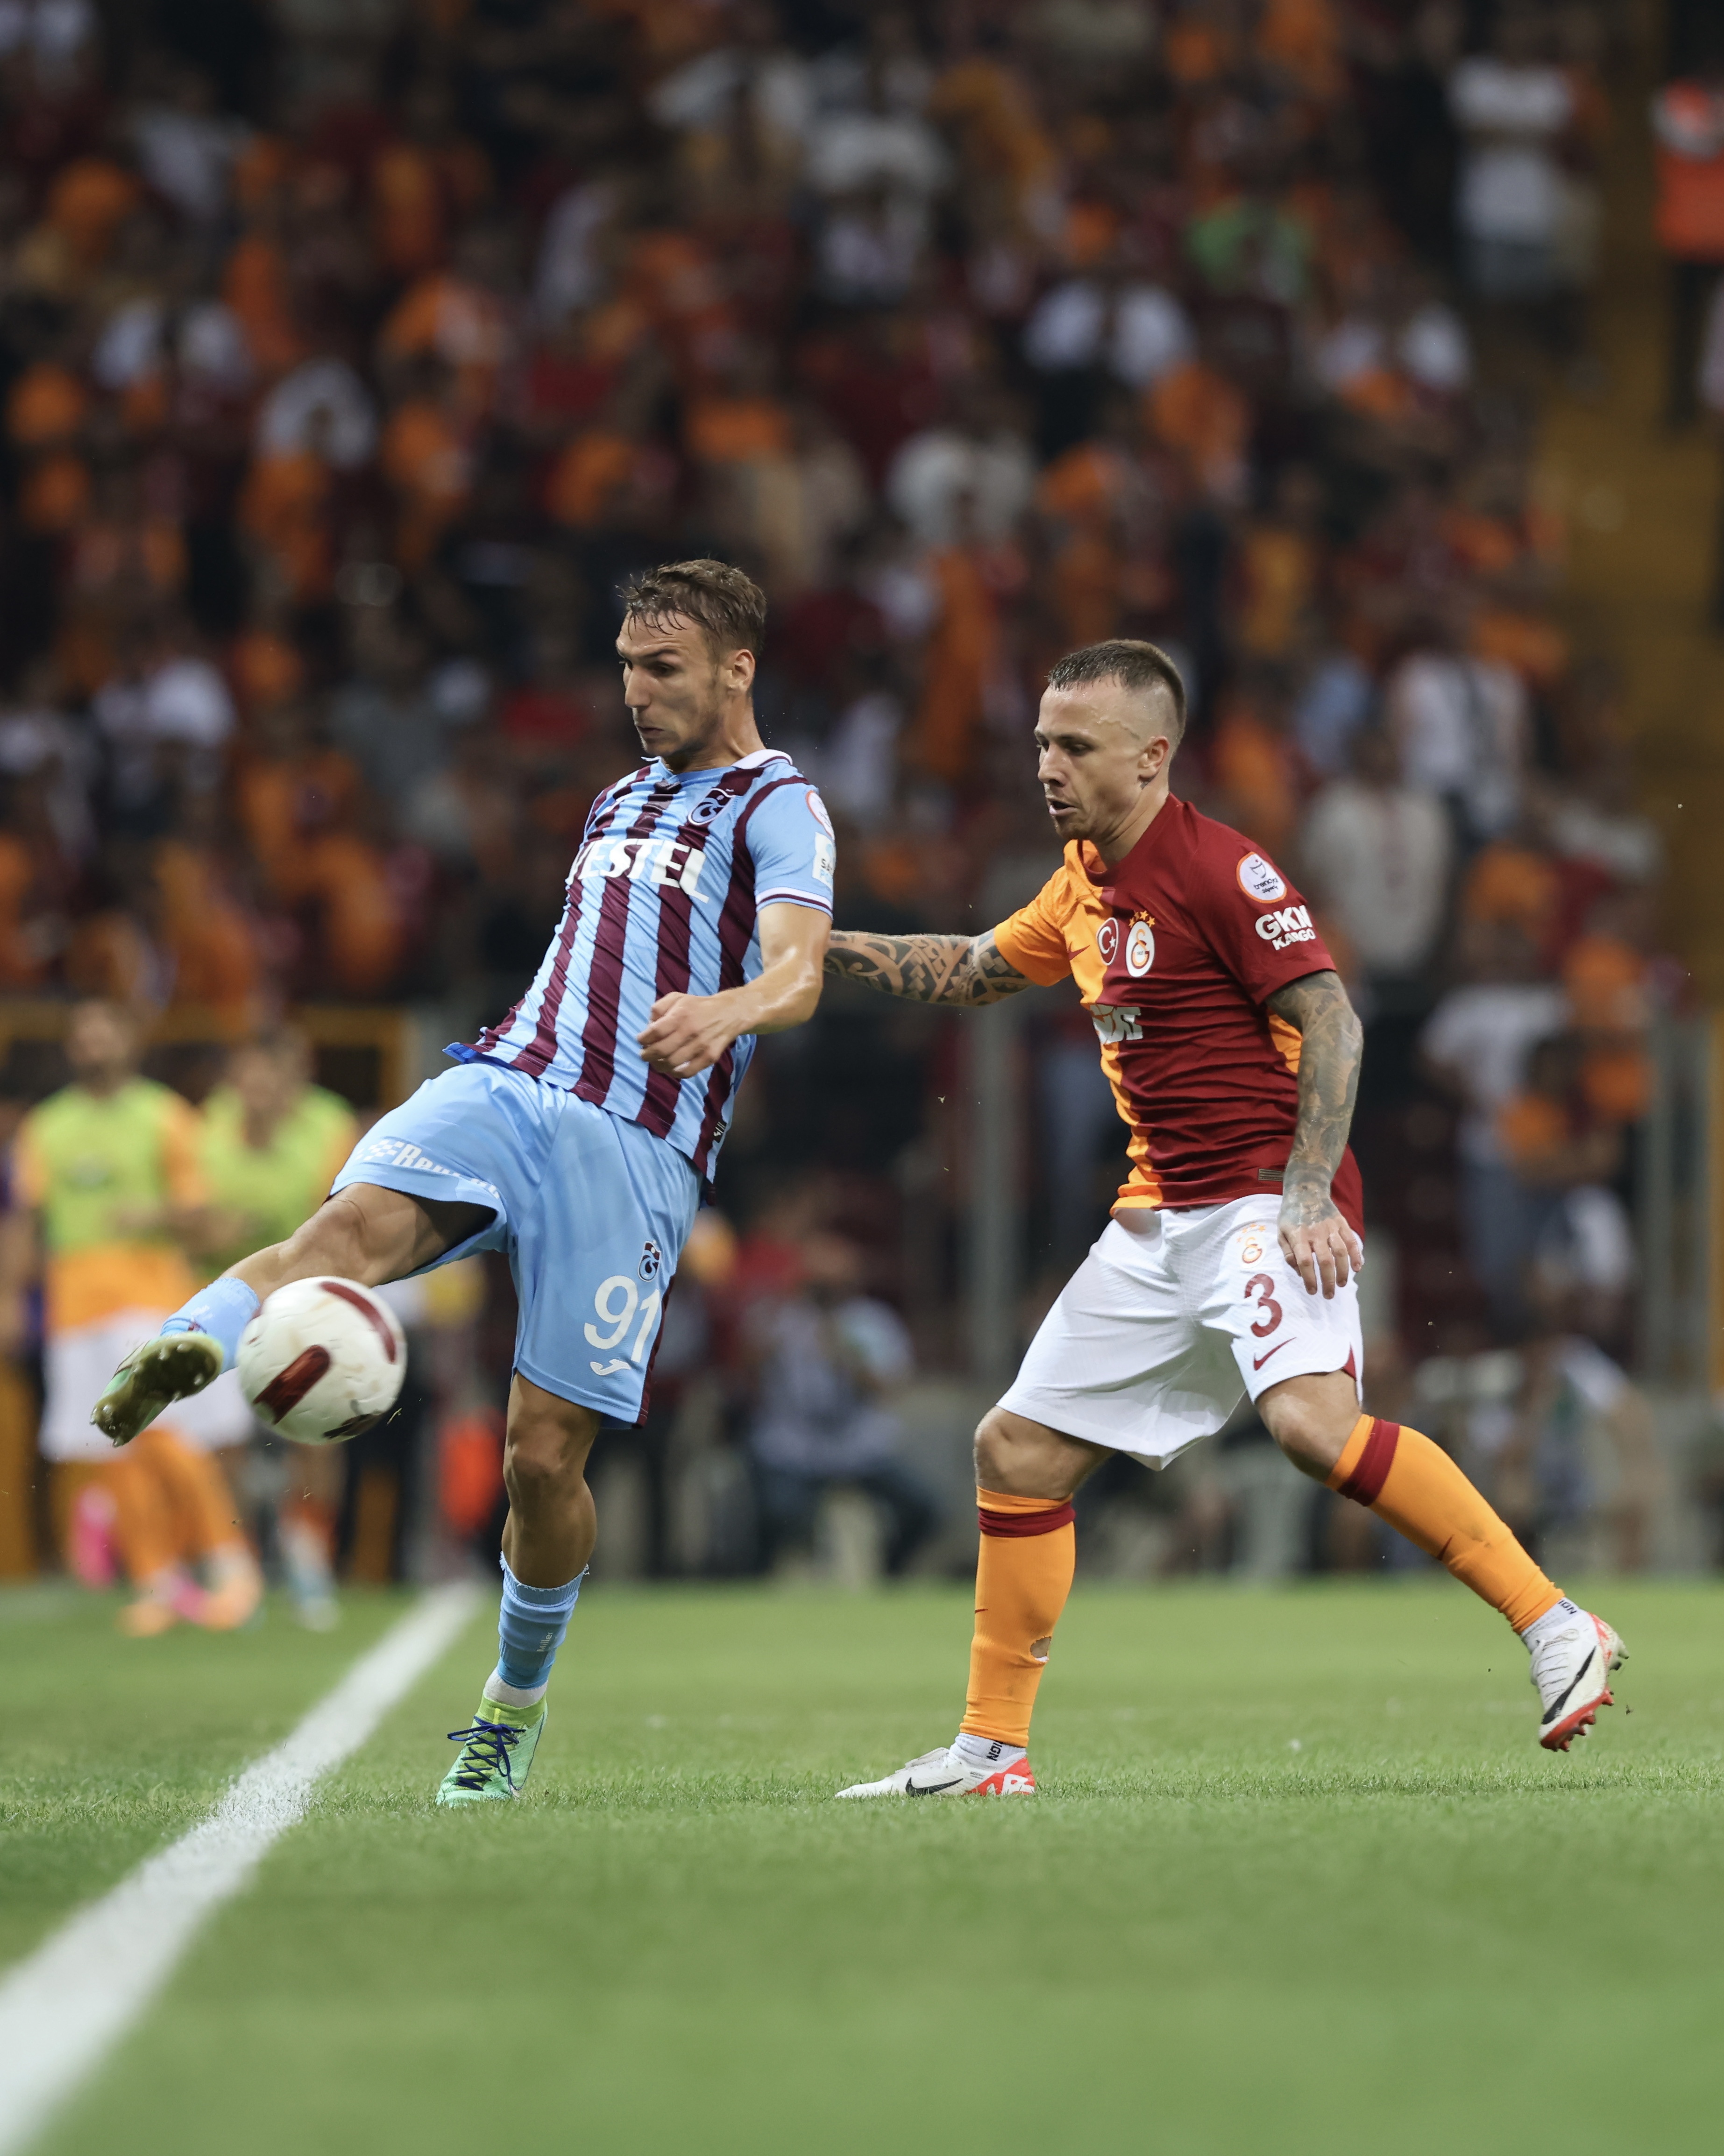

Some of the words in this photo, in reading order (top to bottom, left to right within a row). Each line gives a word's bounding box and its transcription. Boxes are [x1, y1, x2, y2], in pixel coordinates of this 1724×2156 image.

[565, 838, 709, 904] VESTEL
[1255, 905, 1313, 940] GKN
[1272, 928, 1316, 950] KARGO
[584, 1275, 660, 1363] 91
[1245, 1273, 1282, 1337] 3
[537, 1632, 553, 1652] Miller
[986, 1741, 1003, 1761] IGN
